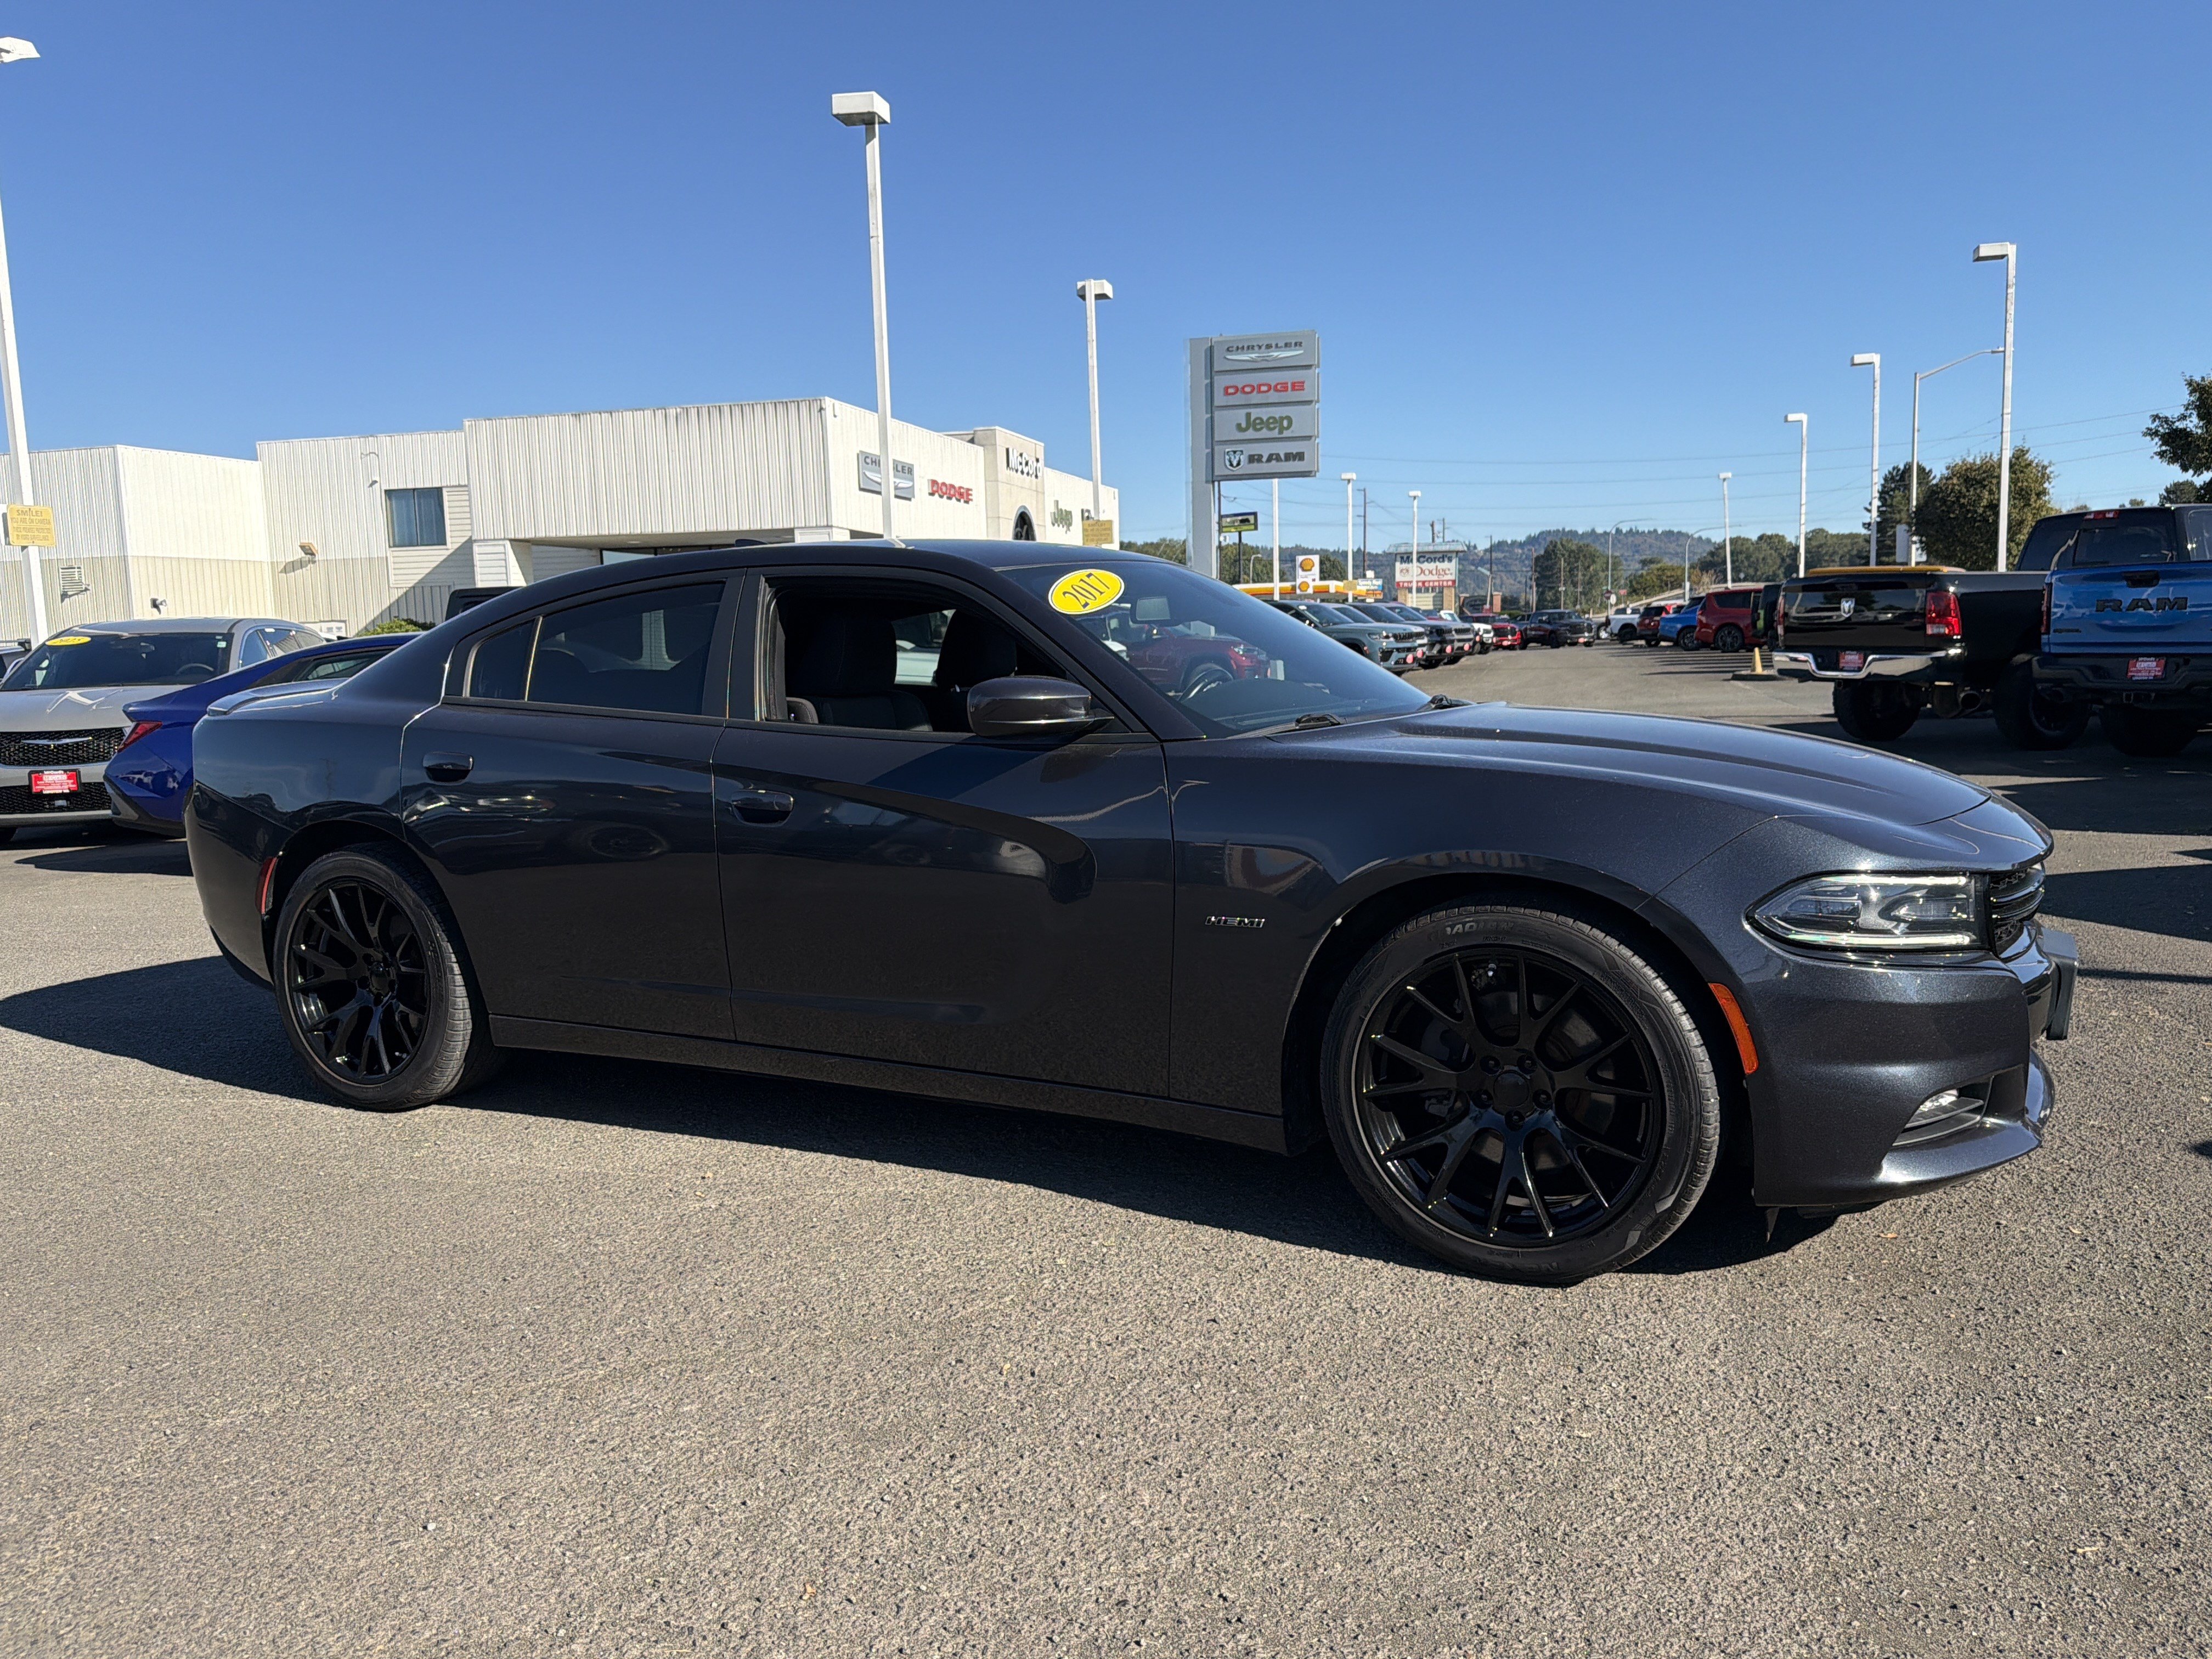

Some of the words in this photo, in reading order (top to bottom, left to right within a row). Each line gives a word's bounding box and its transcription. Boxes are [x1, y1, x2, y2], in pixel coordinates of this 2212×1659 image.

[1226, 341, 1303, 353] CHRYSLER
[1224, 381, 1305, 396] DODGE
[1236, 412, 1293, 435] Jeep
[864, 456, 913, 476] CHLER
[1006, 447, 1042, 479] McCord
[1248, 452, 1305, 464] RAM
[928, 479, 973, 503] DODGE
[1062, 572, 1110, 609] 2017
[2095, 597, 2188, 612] RAM
[1205, 916, 1265, 928] HEMI
